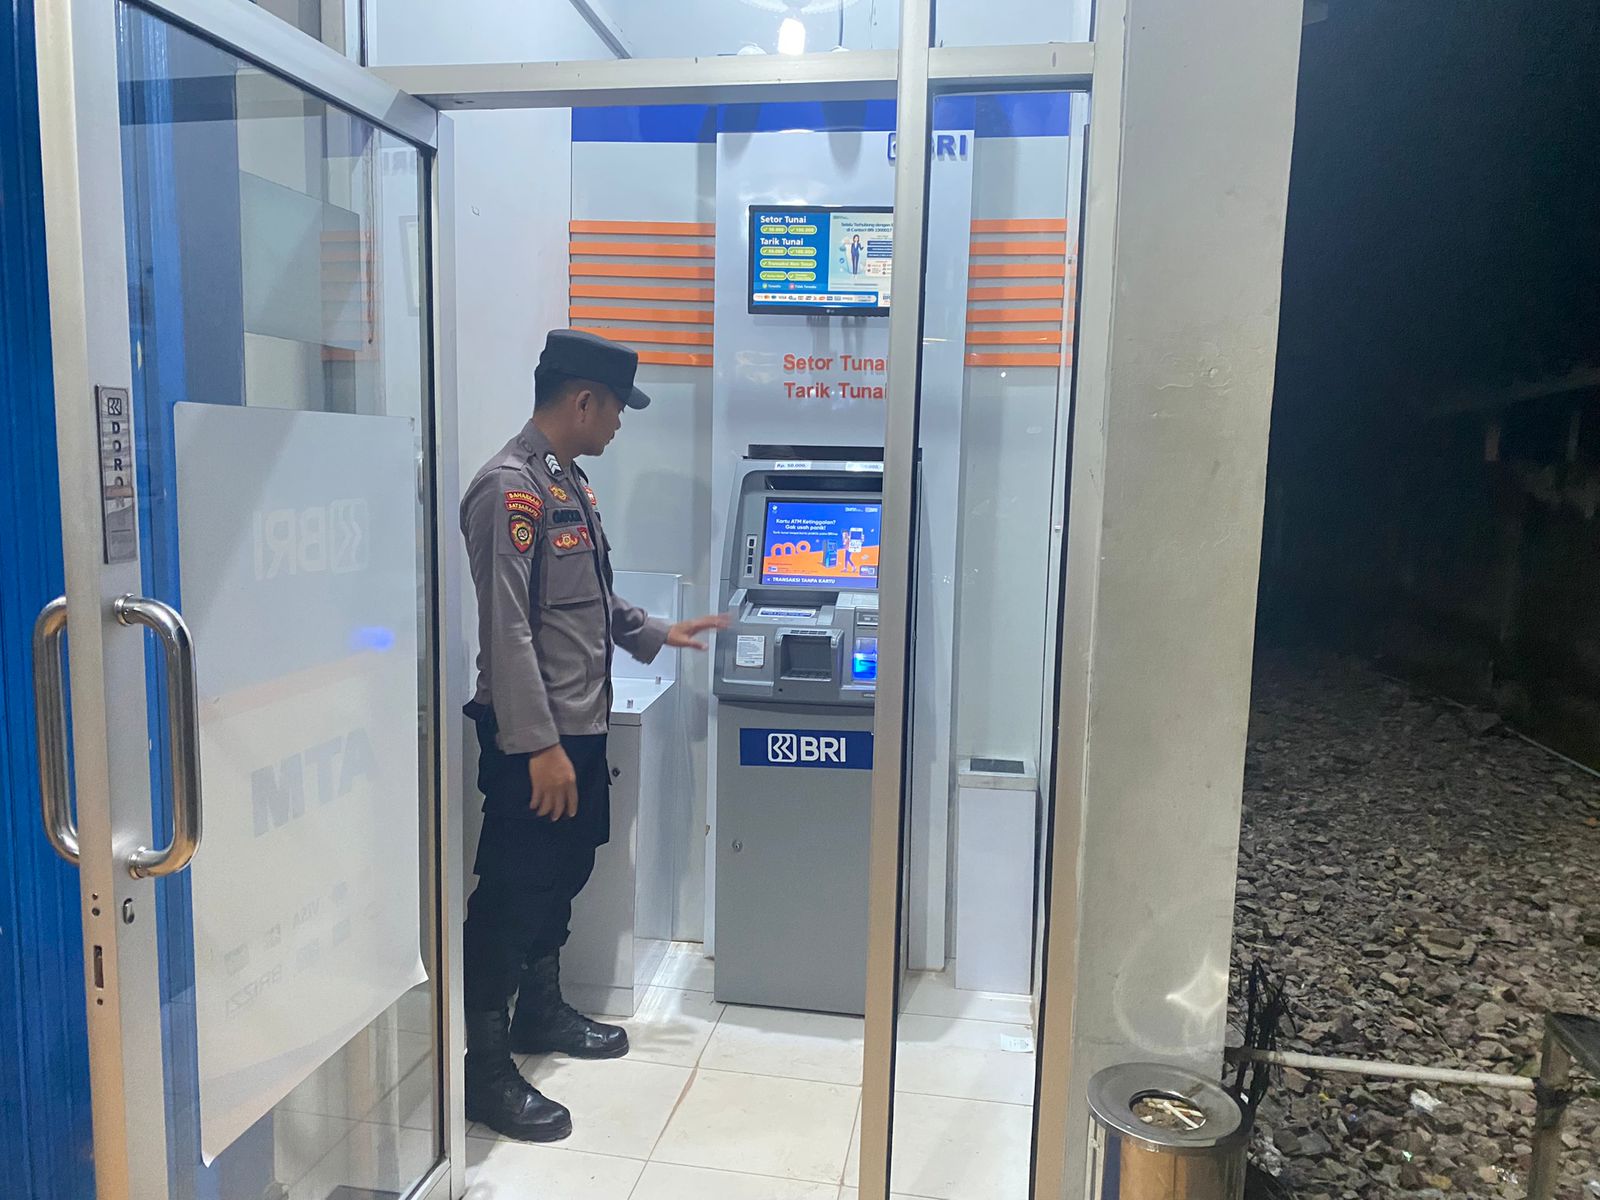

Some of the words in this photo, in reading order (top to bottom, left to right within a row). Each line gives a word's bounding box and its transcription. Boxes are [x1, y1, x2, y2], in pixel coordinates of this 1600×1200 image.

[931, 134, 967, 156] RI
[760, 215, 782, 223] Setor
[784, 215, 807, 223] Tunai
[760, 237, 780, 245] Tarik
[783, 353, 833, 372] Setor
[783, 382, 830, 399] Tarik
[800, 736, 847, 763] BRI
